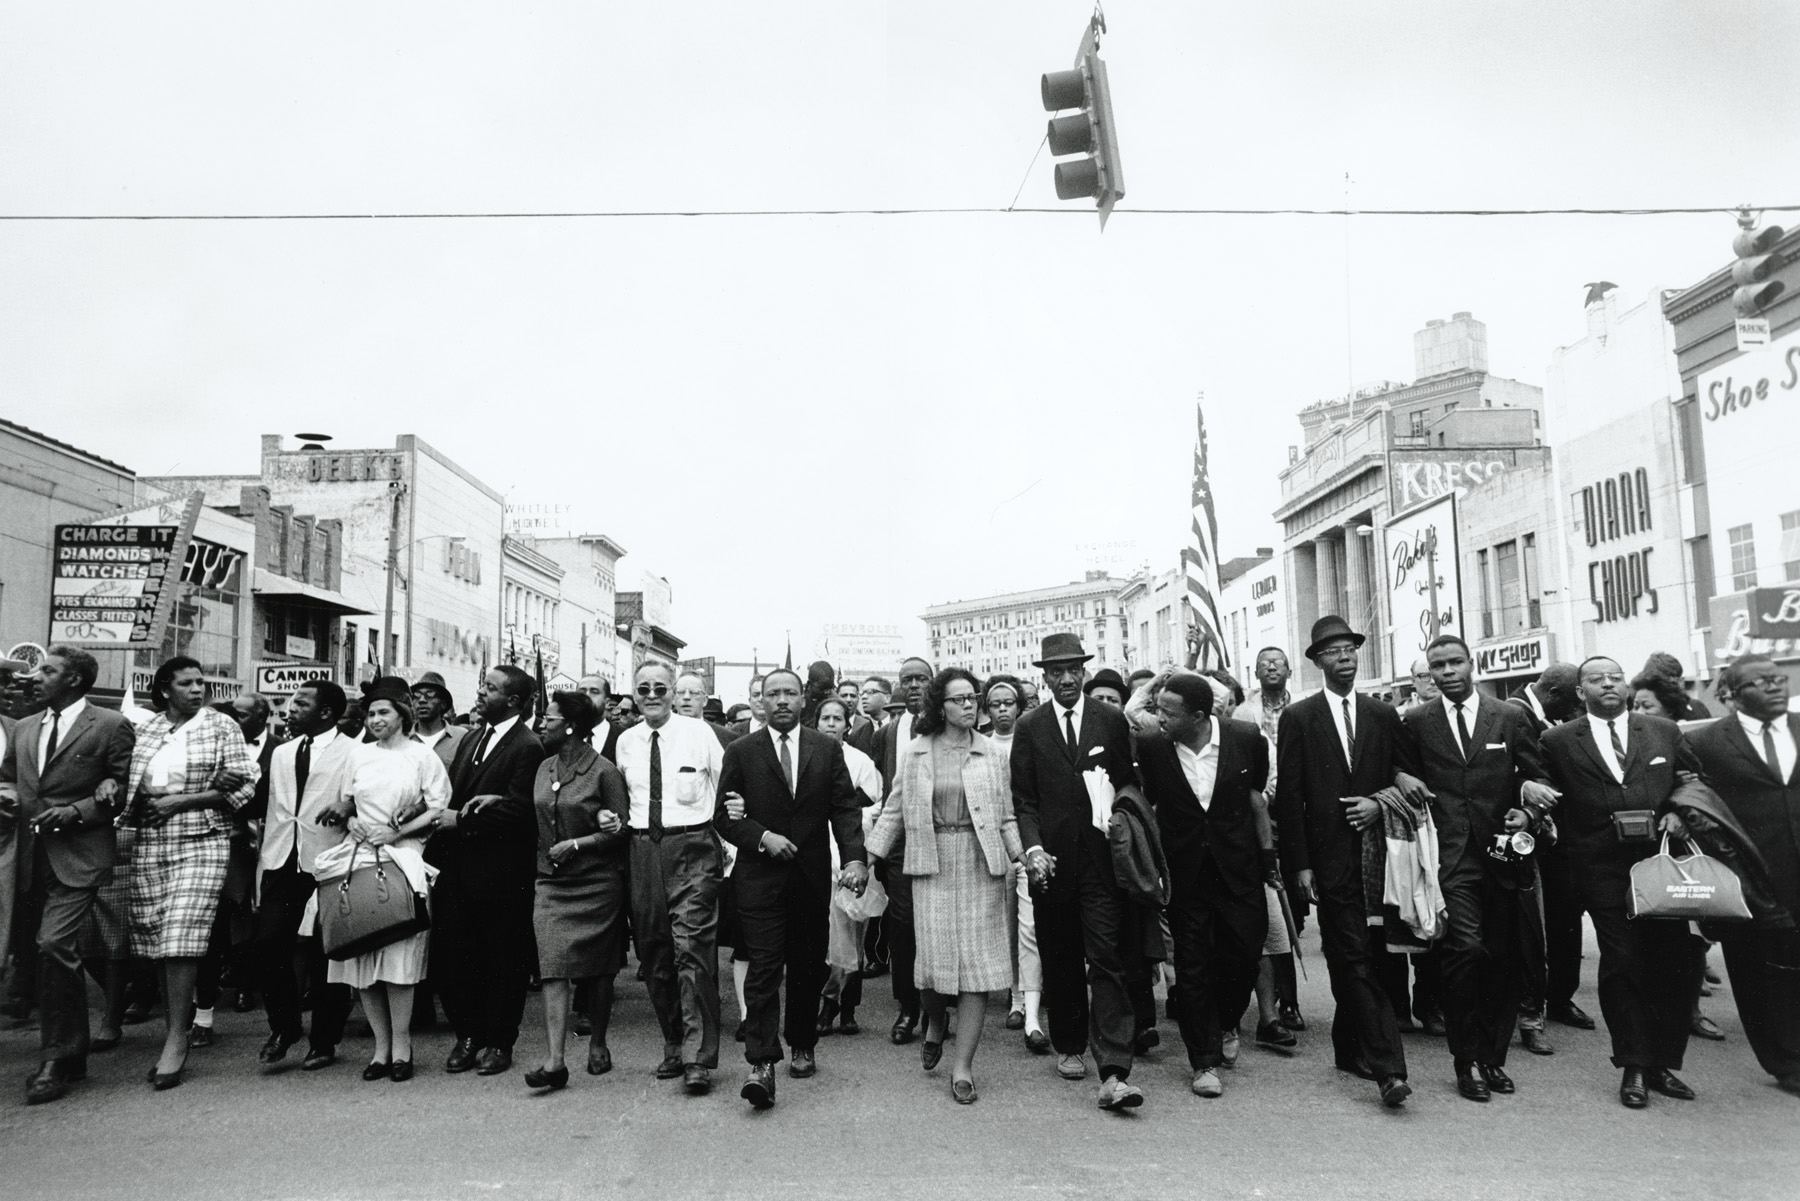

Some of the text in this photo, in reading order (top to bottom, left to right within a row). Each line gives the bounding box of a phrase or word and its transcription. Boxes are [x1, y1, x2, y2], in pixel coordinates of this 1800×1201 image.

[1739, 324, 1767, 335] PARKING
[1705, 377, 1769, 422] Shoe
[308, 456, 401, 482] BELK'S
[505, 504, 570, 513] WHITLEY
[1582, 467, 1652, 547] DIANA
[61, 527, 173, 542] CHARGE IT
[60, 547, 151, 561] DIAMONDS
[60, 564, 150, 578] WATCHES
[1588, 546, 1659, 624] SHOPS
[54, 596, 138, 607] EYES EXAMINED
[131, 562, 167, 640] BERNS
[102, 612, 137, 622] FITTED
[822, 624, 899, 635] CHEVROLET
[1476, 640, 1542, 676] MY SHOP
[264, 669, 329, 684] CANNON
[1666, 885, 1715, 893] EASTERN
